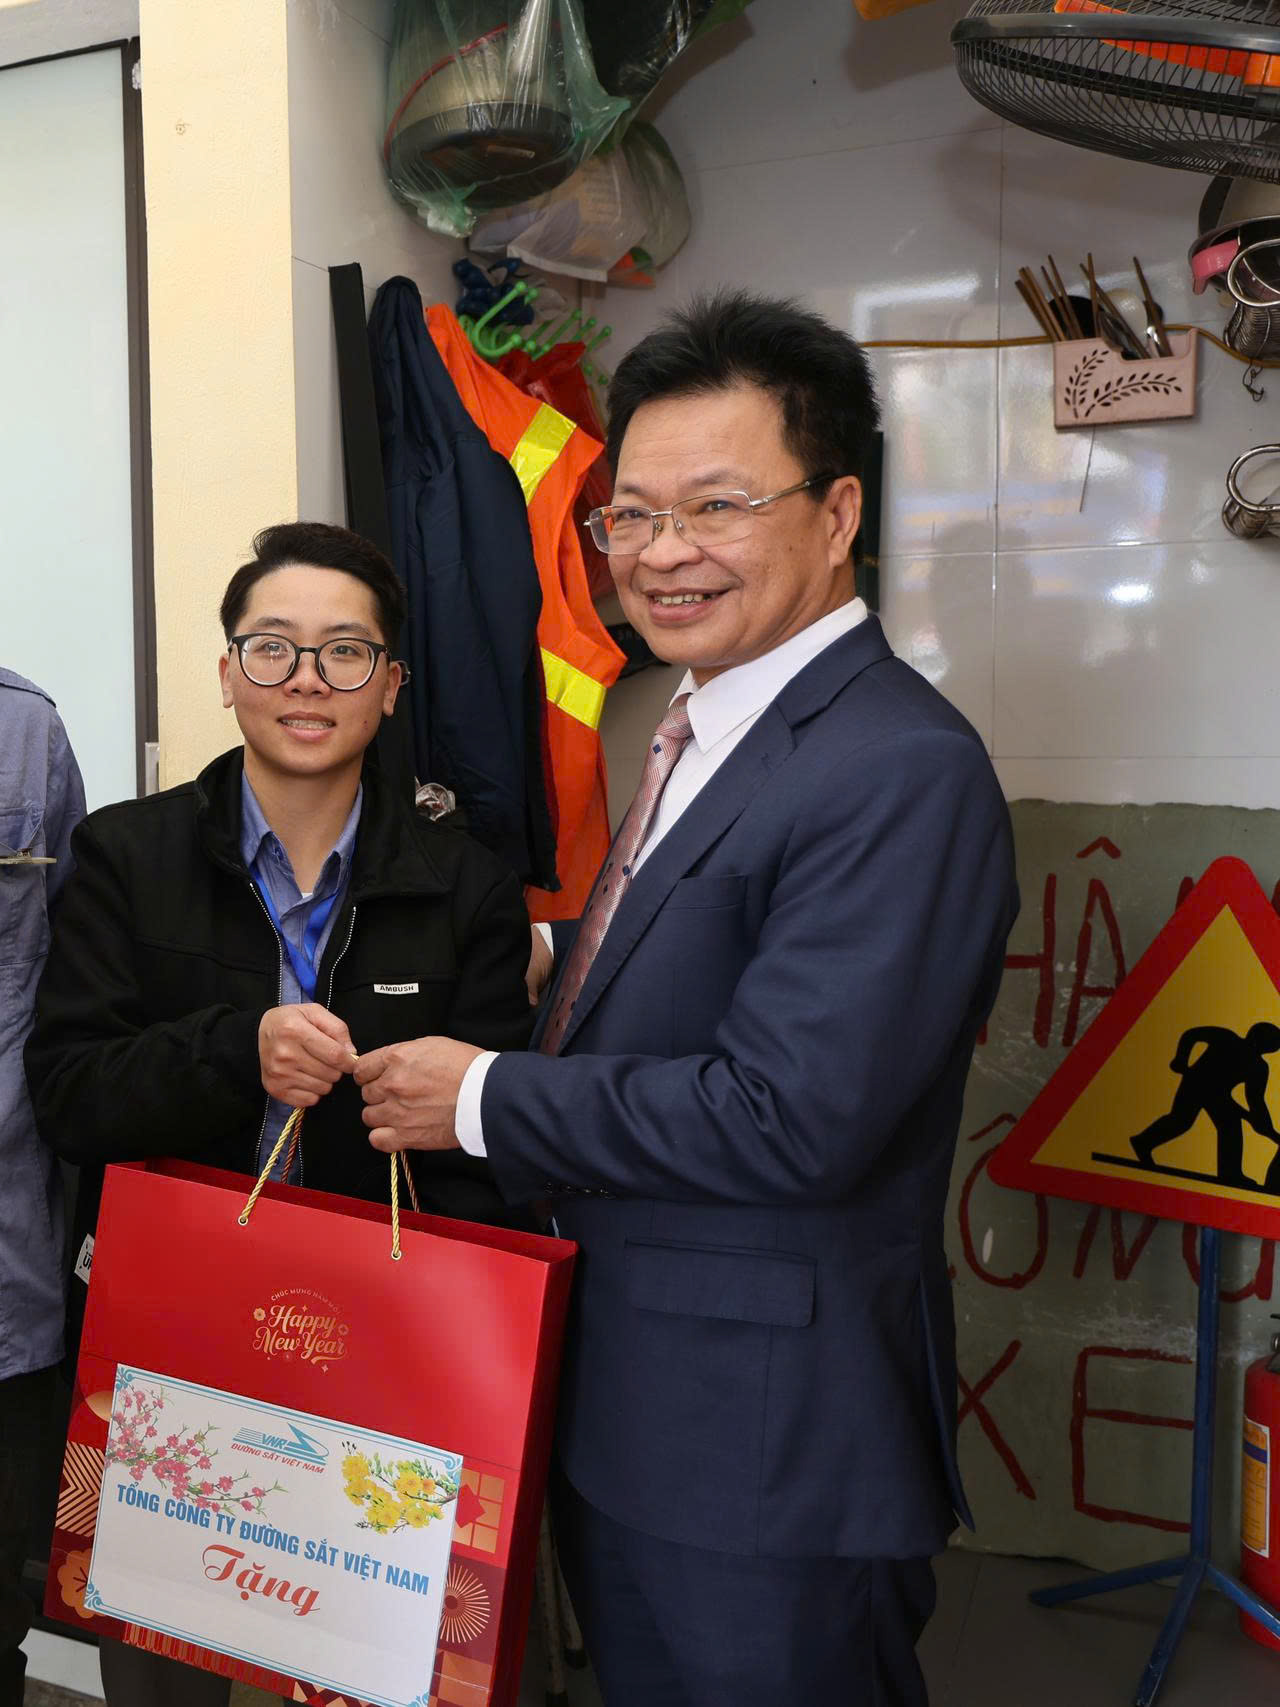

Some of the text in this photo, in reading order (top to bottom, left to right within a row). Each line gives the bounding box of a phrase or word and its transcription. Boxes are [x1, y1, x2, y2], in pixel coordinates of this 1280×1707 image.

[268, 1305, 337, 1339] Happy
[253, 1326, 346, 1364] New Year
[261, 1433, 288, 1450] VNR
[302, 1462, 325, 1474] NAM
[117, 1481, 429, 1596] TỔNG CÔNG TY ĐƯỜNG SẮT VIỆT NAM
[202, 1544, 321, 1616] Tặng
